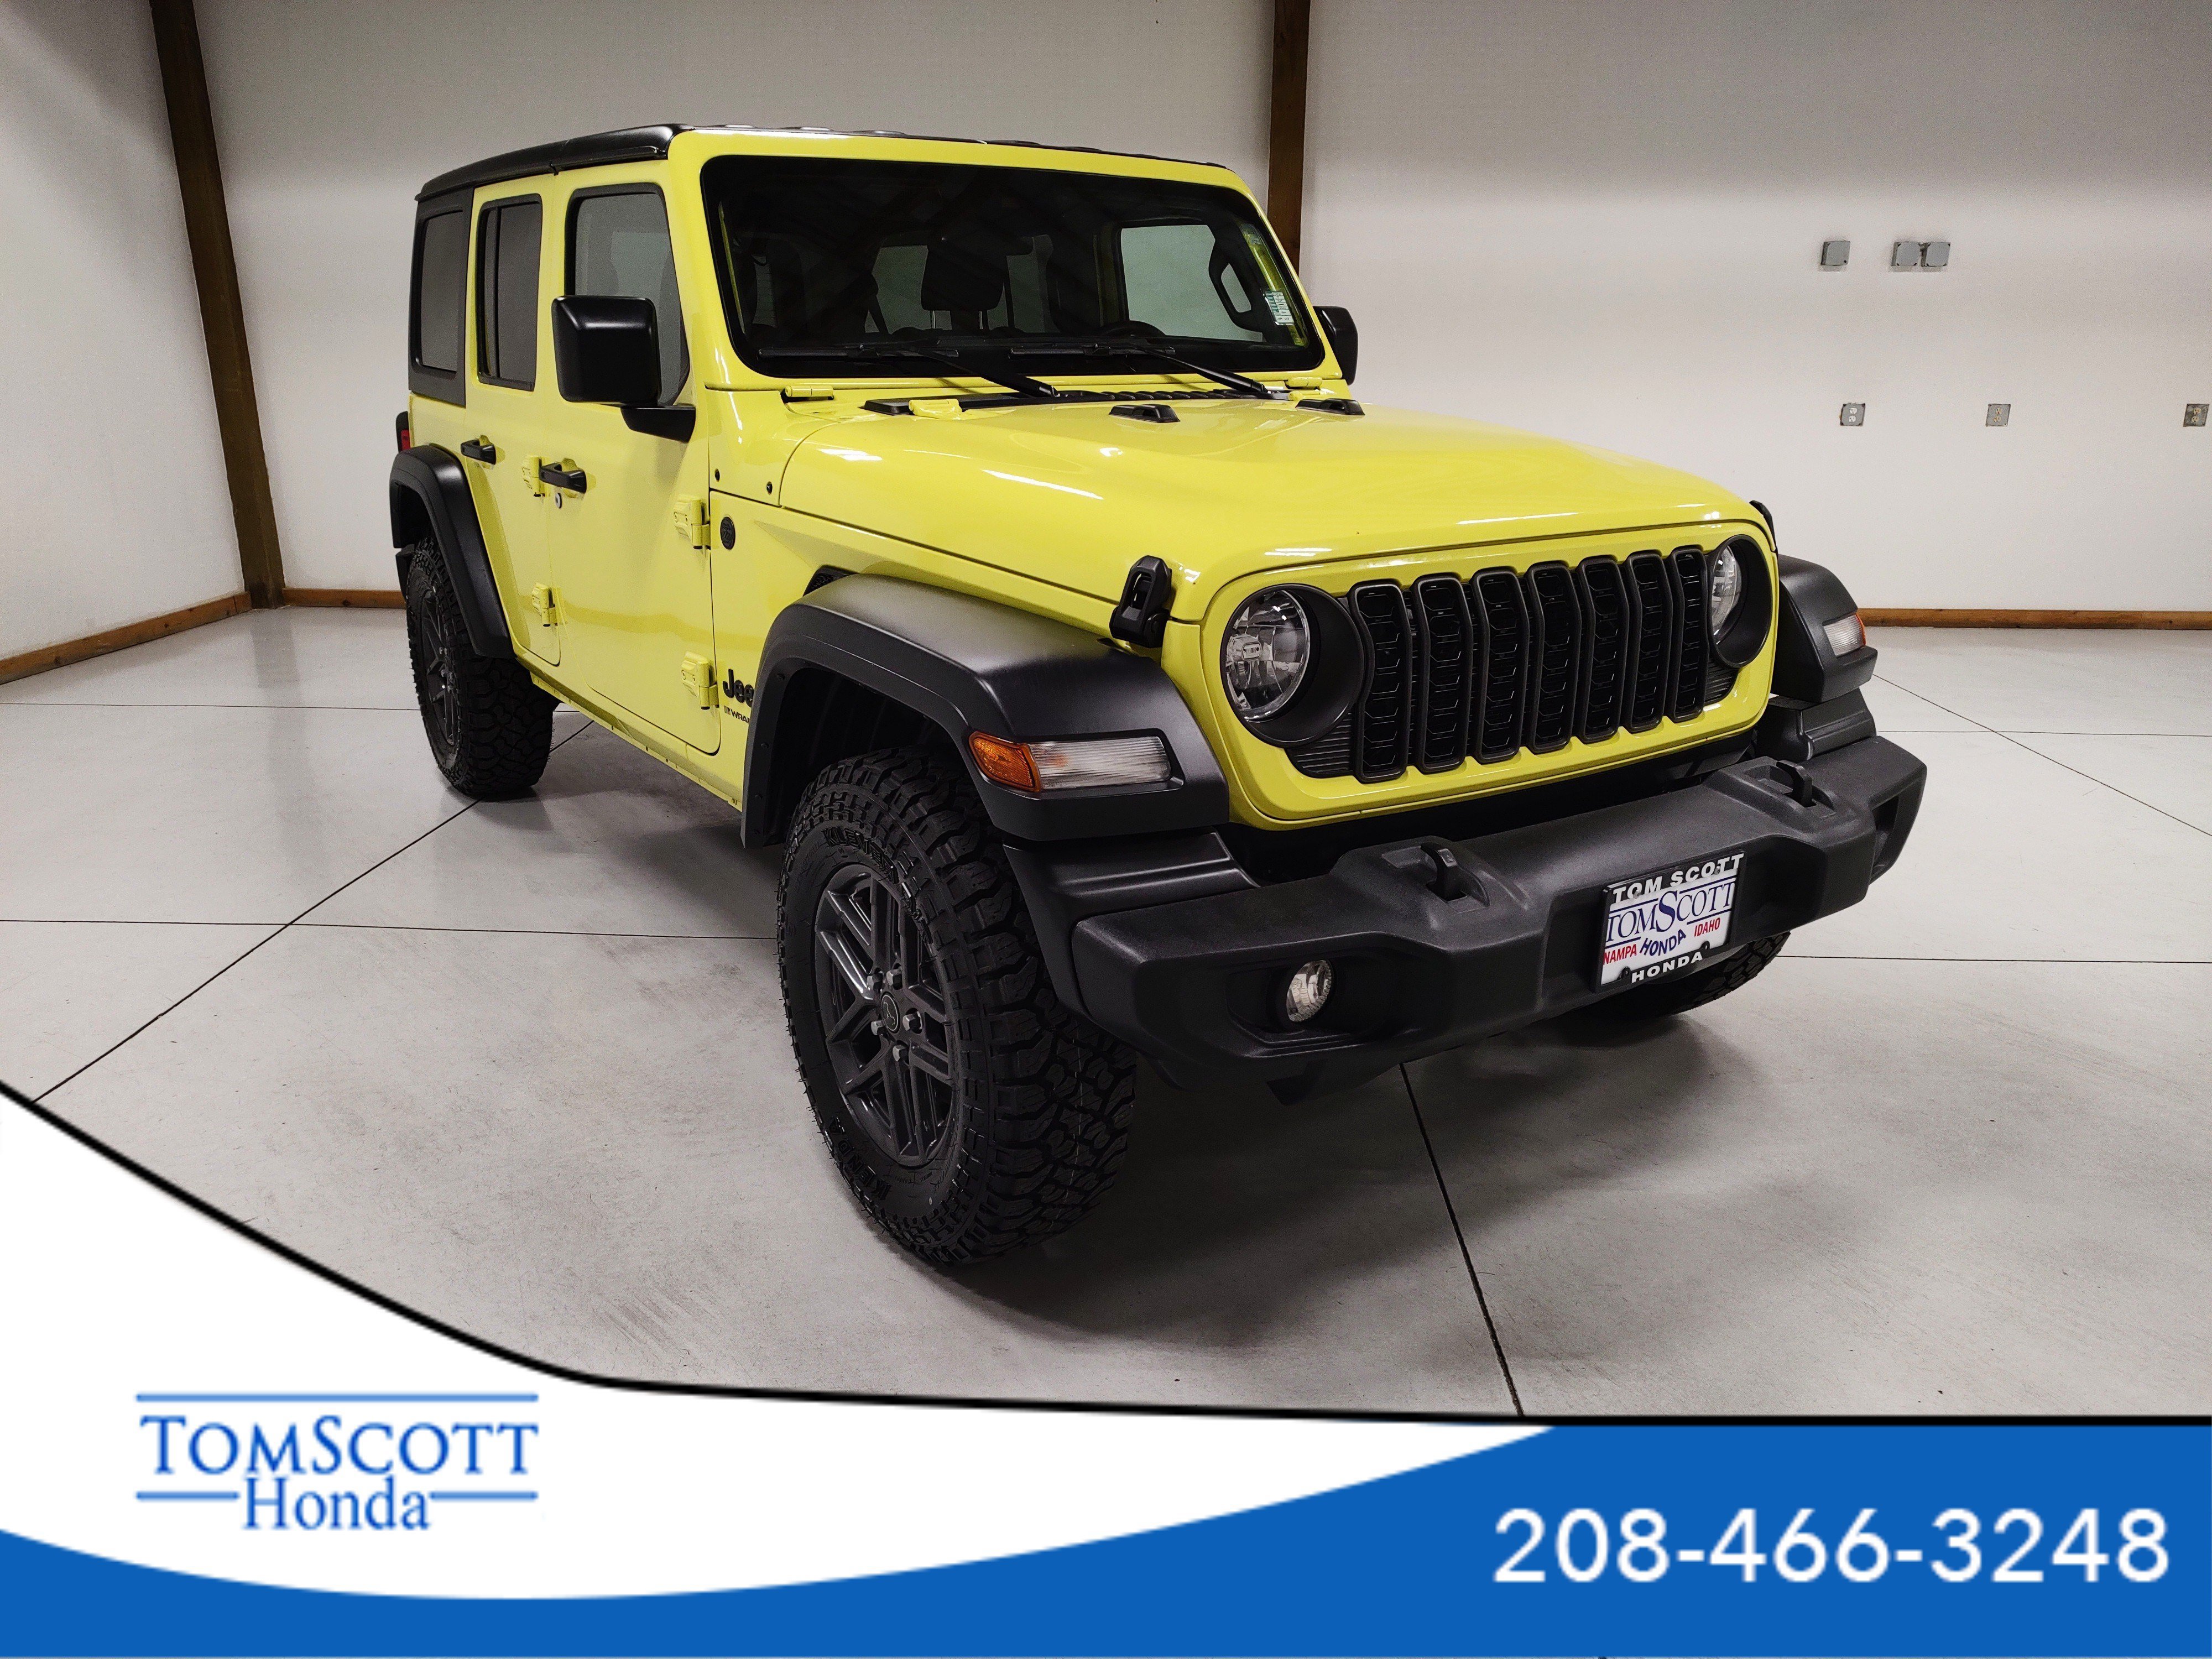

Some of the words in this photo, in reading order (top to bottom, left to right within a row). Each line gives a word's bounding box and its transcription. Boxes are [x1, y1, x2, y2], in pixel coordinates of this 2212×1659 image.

[722, 669, 754, 708] Jee
[1613, 876, 1662, 904] TOM
[1670, 853, 1744, 887] SCOTT
[1606, 882, 1736, 942] TOMSCOTT
[1694, 917, 1721, 937] IDAHO
[1604, 943, 1637, 964] NAMPA
[1640, 928, 1686, 956] HONDA
[1631, 951, 1703, 983] HONDA
[827, 1116, 891, 1201] KENDA
